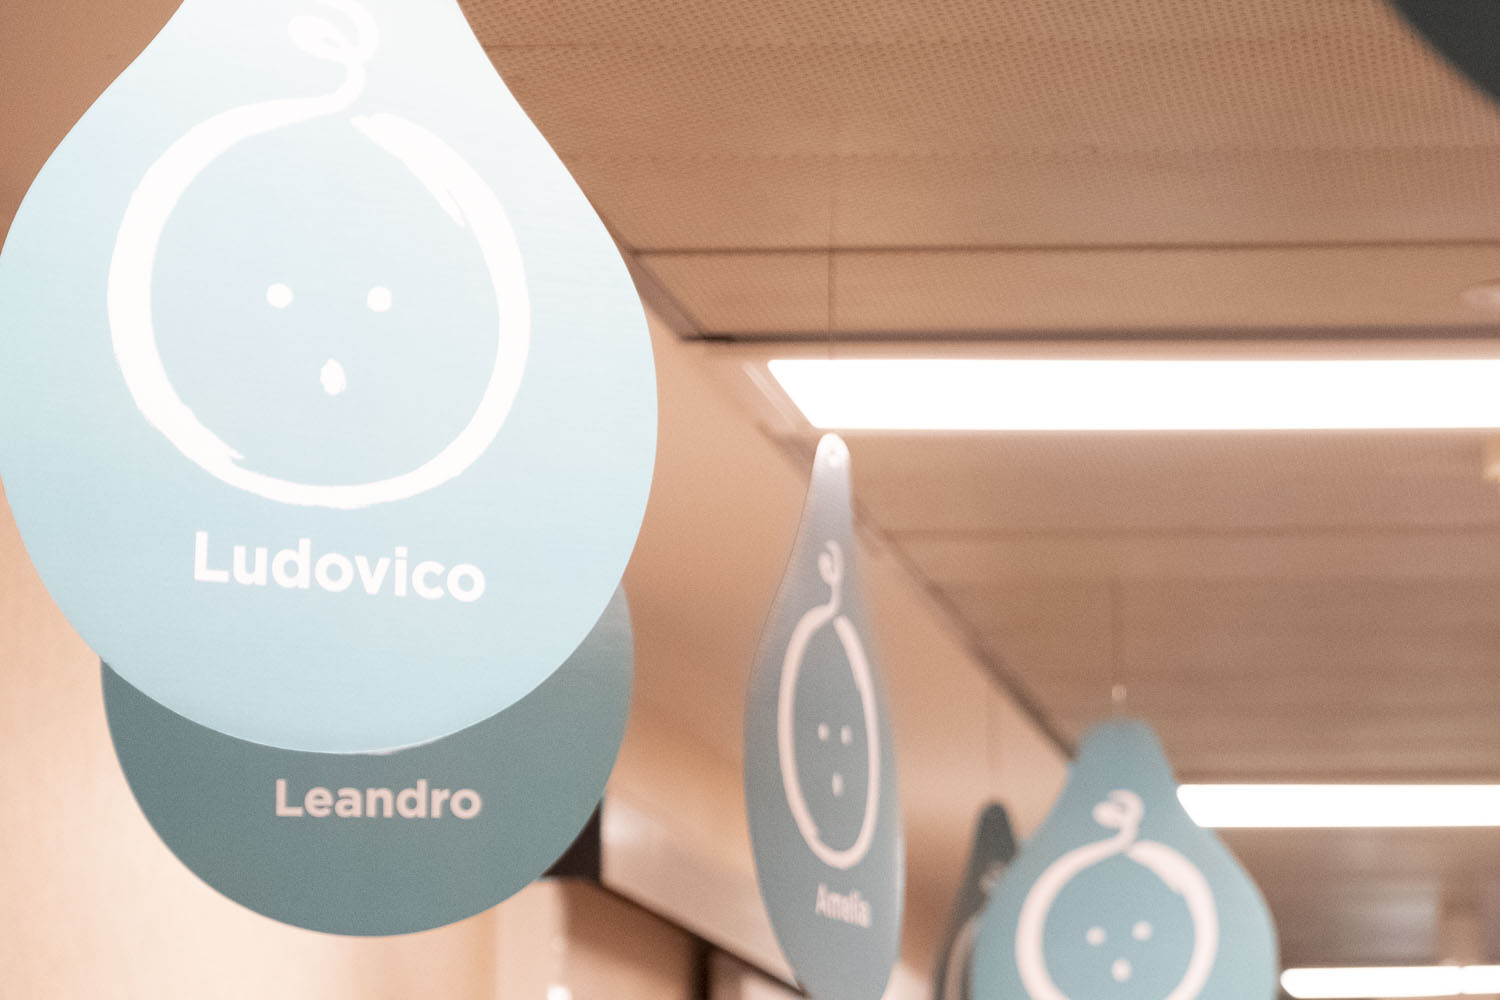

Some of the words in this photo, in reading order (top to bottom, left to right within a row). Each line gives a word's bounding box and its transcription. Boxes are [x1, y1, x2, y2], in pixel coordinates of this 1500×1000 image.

[193, 531, 487, 602] Ludovico
[274, 778, 483, 820] Leandro
[815, 883, 872, 929] Amelia
